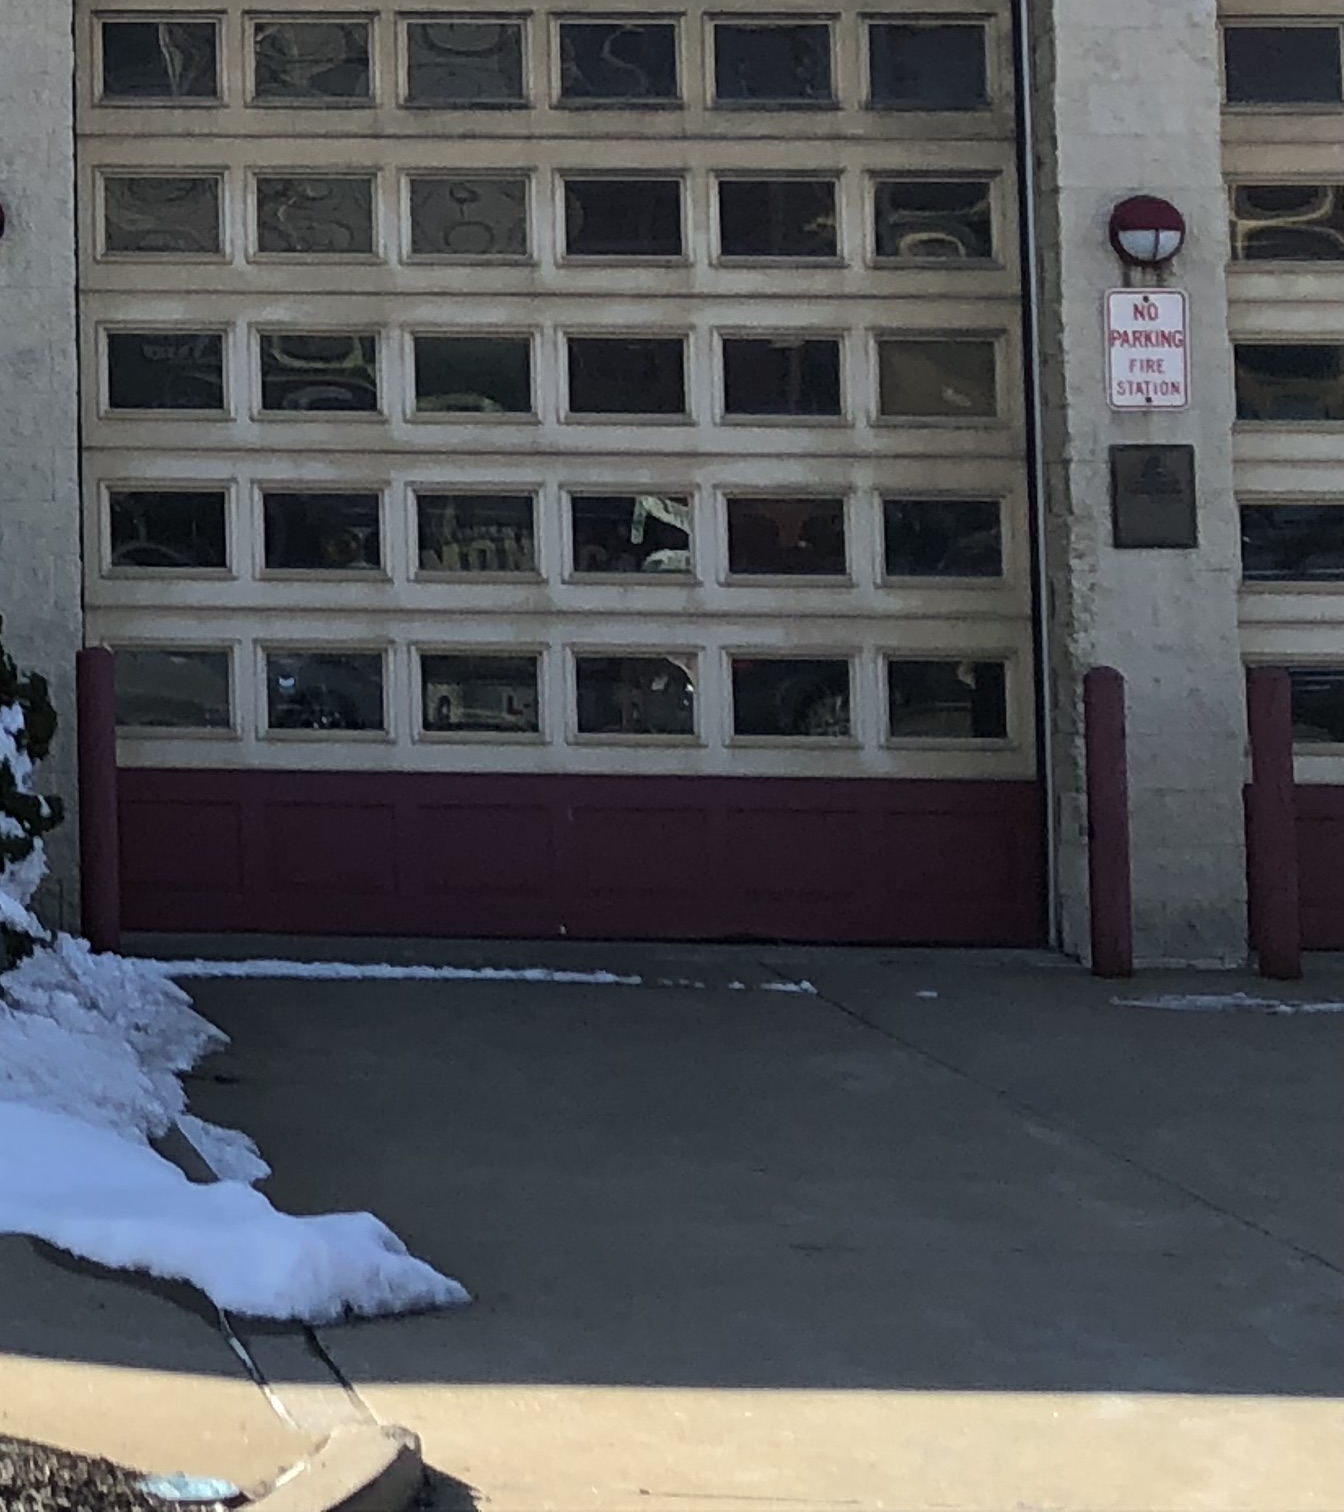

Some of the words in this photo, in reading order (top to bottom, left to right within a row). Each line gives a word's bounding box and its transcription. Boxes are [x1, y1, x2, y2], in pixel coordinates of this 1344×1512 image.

[1132, 303, 1159, 322] NO
[1111, 330, 1184, 349] PARKING
[1128, 359, 1165, 374] FIRE
[1117, 380, 1182, 396] STATION
